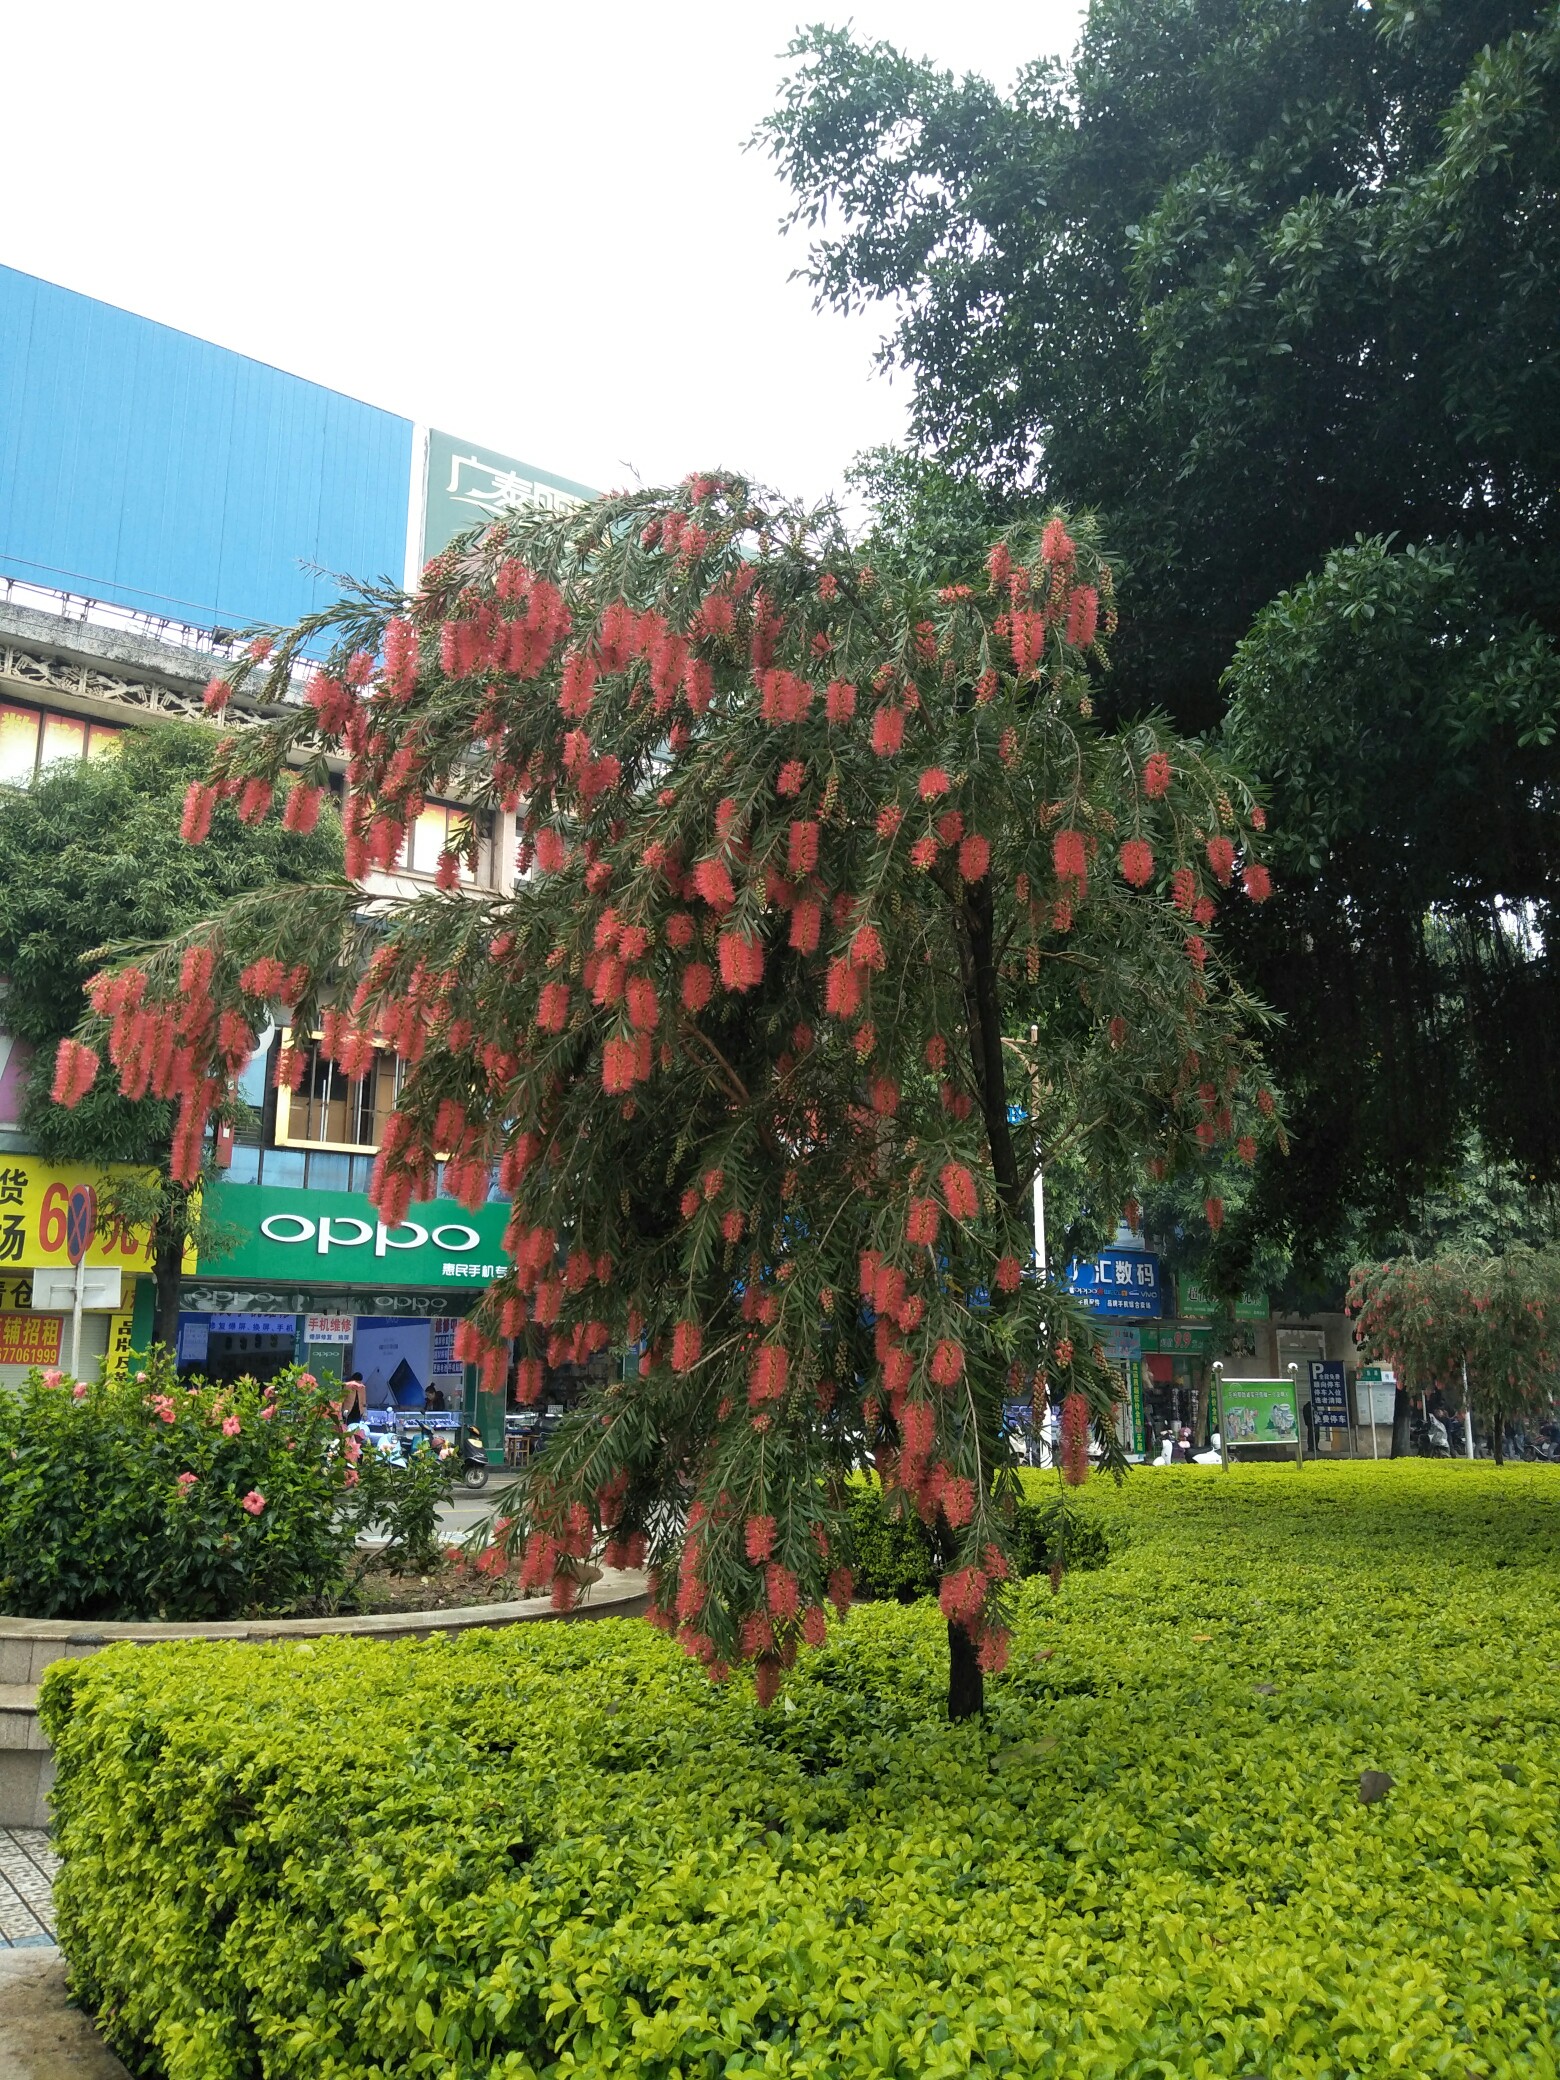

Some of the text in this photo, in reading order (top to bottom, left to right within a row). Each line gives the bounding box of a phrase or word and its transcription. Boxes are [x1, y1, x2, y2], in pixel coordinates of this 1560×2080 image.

[442, 1262, 520, 1278] 惠民手机专
[0, 1280, 32, 1309] 仓
[0, 1316, 59, 1346] 辅招租
[308, 1317, 352, 1332] 手机维修
[1312, 1362, 1324, 1380] P
